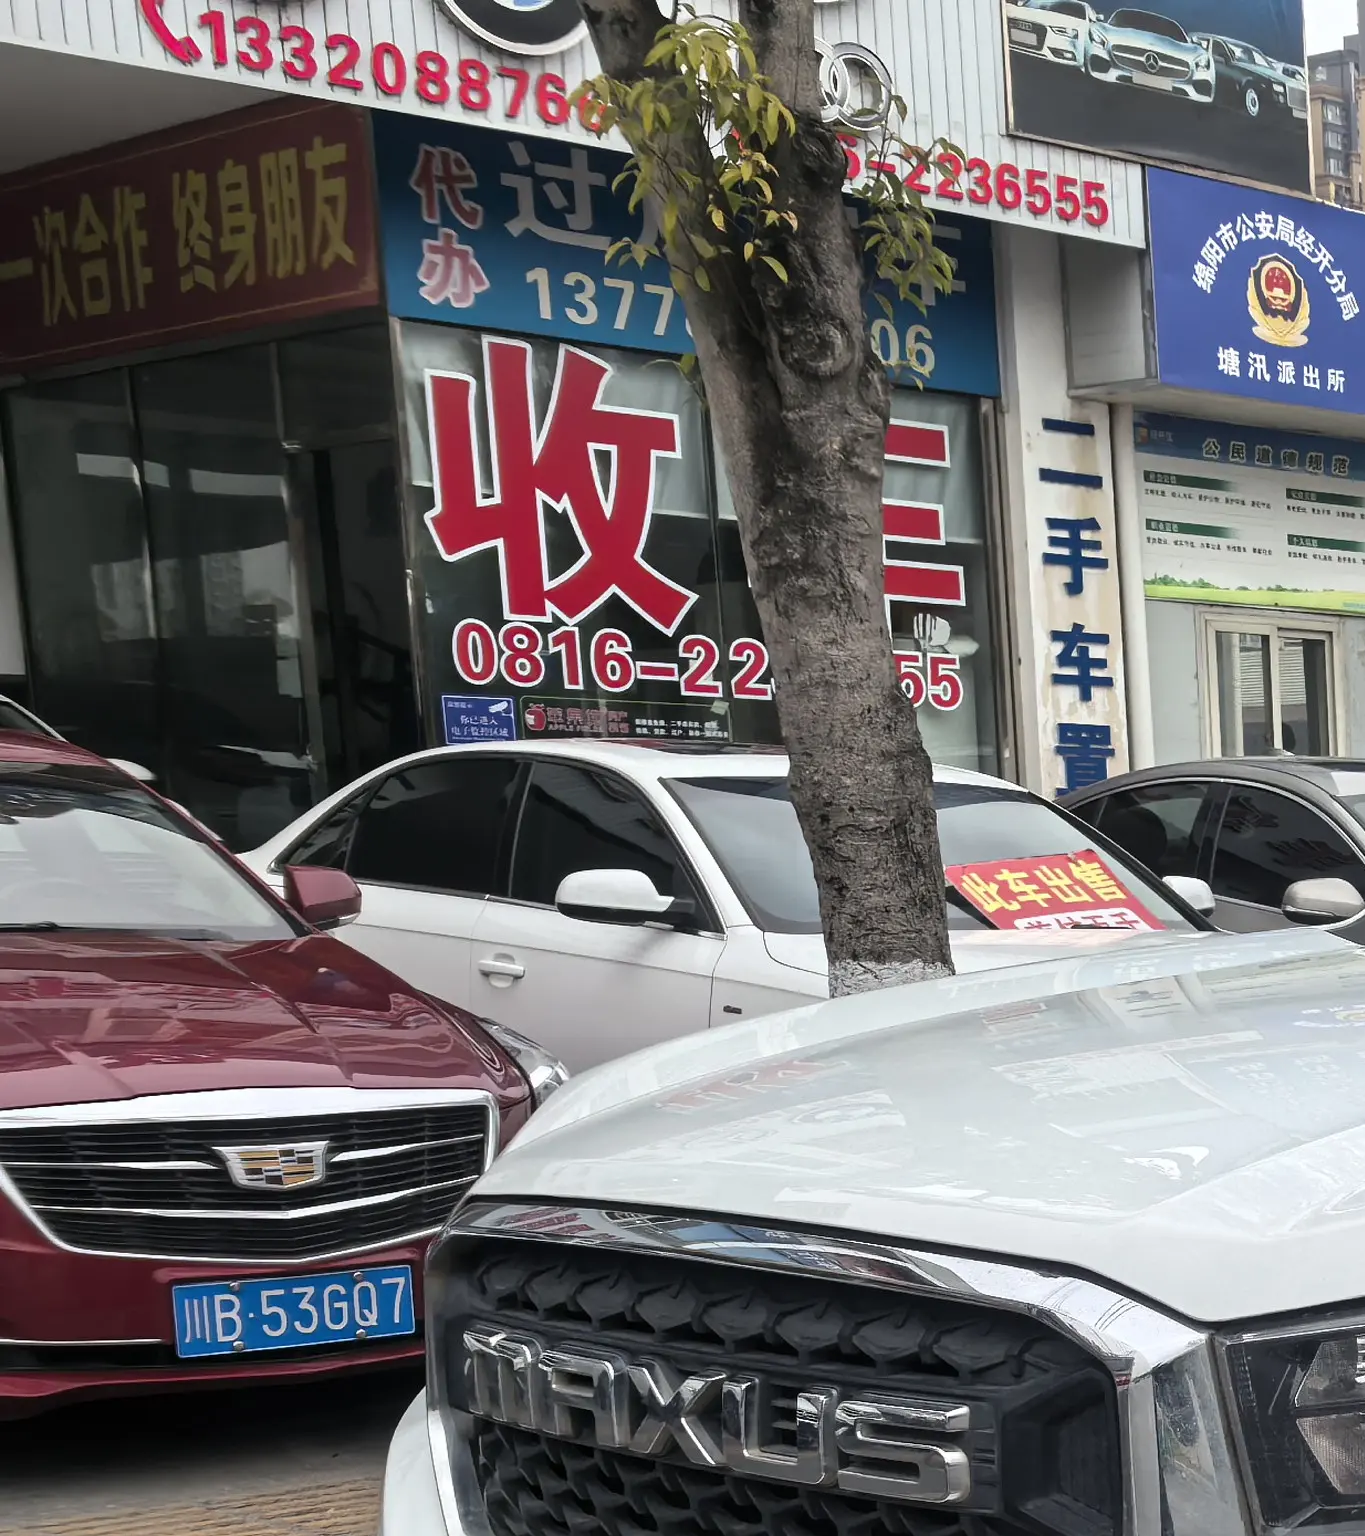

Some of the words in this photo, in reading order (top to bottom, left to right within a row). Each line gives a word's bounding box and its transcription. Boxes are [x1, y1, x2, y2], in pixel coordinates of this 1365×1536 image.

[0, 185, 153, 328] 一次合作
[172, 135, 358, 296] 终身朋友
[410, 143, 490, 308] 代办
[1192, 210, 1361, 322] 绵阳市公安局经开分局
[526, 266, 936, 380] 137706
[1216, 345, 1347, 394] 塘汛派出所
[1201, 437, 1351, 477] 公民道德规范
[452, 618, 965, 711] 0816-2255
[960, 858, 1128, 914] 此车出售
[183, 1275, 406, 1345] 川B·53GQ7
[461, 1321, 973, 1504] MAXUS
